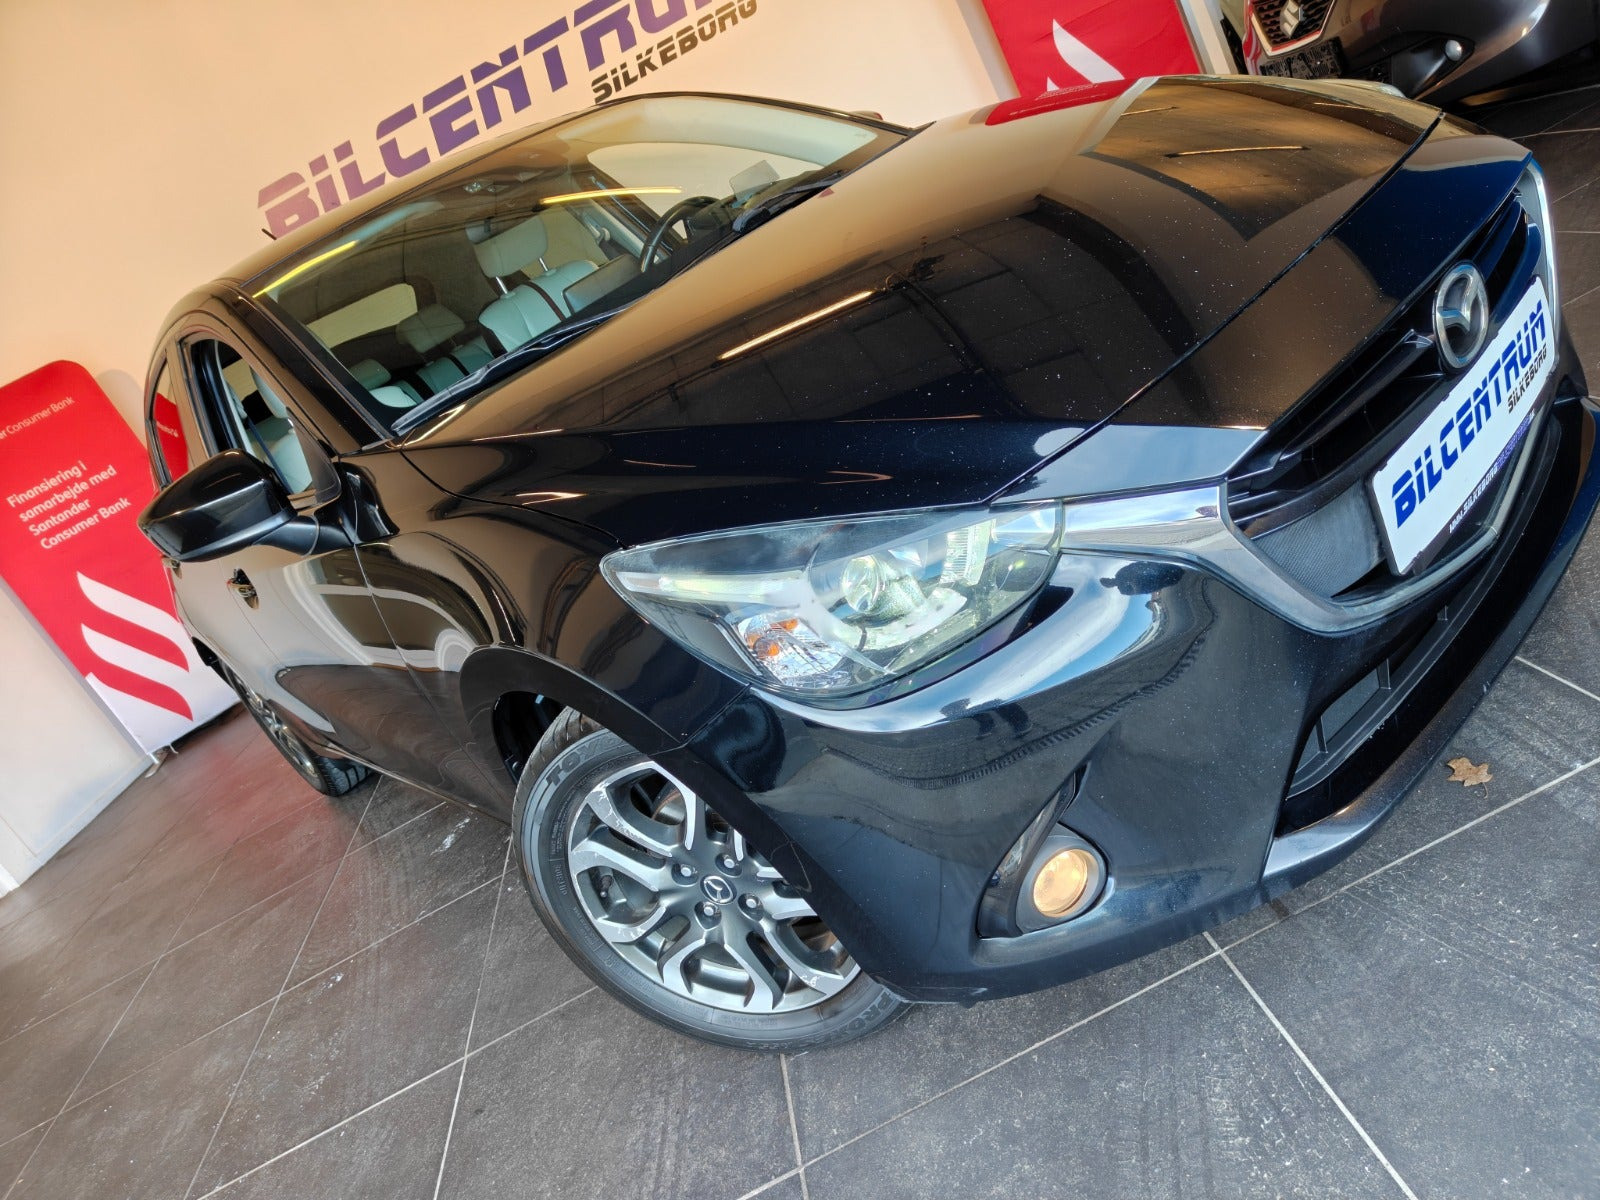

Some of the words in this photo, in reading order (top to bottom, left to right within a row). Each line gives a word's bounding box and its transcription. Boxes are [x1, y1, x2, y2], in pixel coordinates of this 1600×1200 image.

[591, 0, 758, 105] SILKEBORG
[257, 0, 713, 240] BILCENTRU
[1507, 345, 1547, 414] SILKEBORG
[6, 408, 52, 434] Consumer
[50, 396, 75, 412] Bank
[1391, 298, 1546, 529] BILCENTRUM
[6, 465, 83, 508] Finansiering
[78, 460, 88, 471] i
[19, 481, 90, 522] samarbejde
[88, 464, 117, 486] med
[28, 498, 91, 536] Santander
[40, 513, 100, 549] Consumer
[98, 497, 131, 519] Bank
